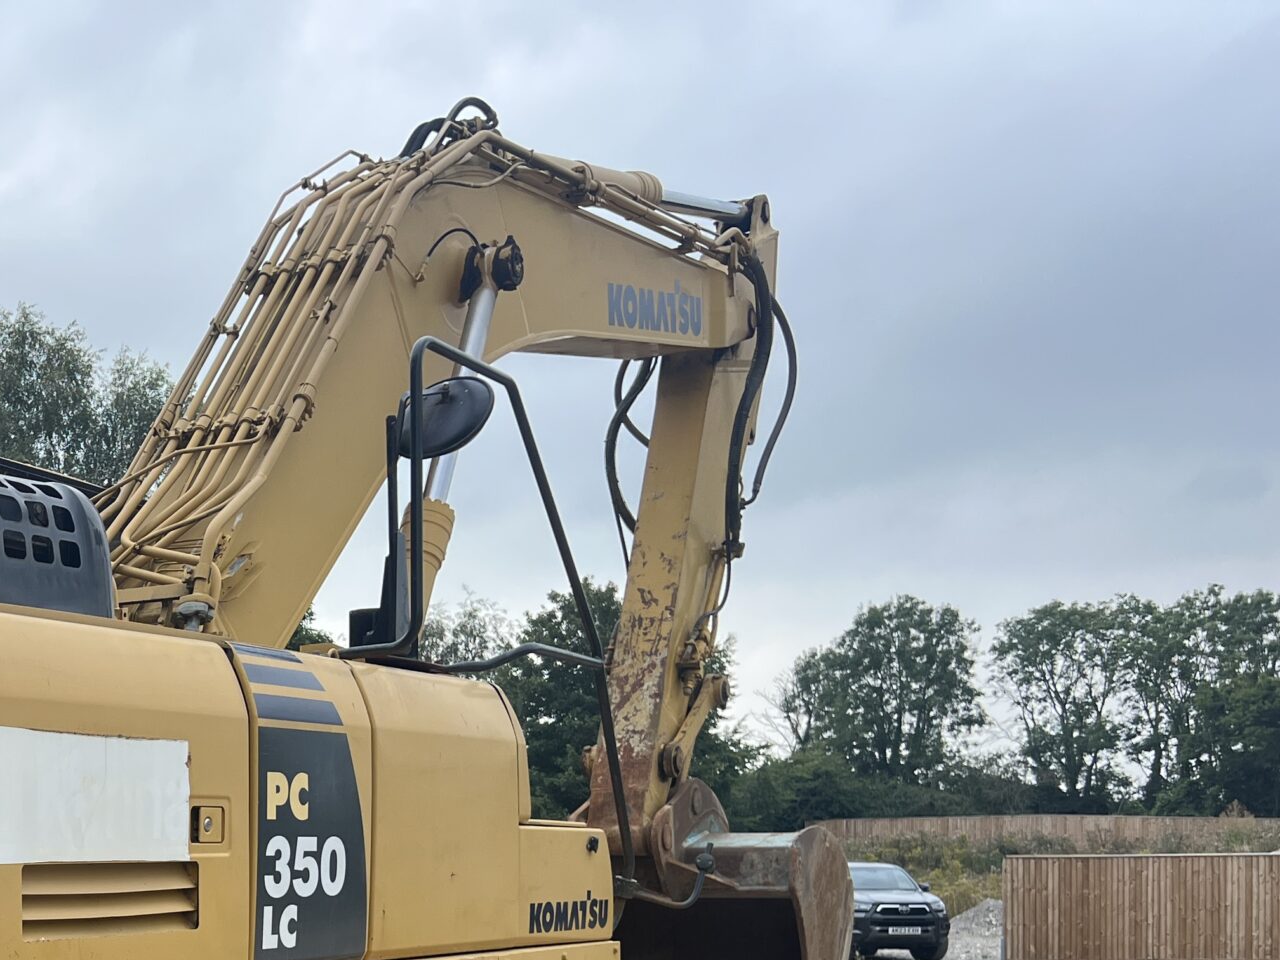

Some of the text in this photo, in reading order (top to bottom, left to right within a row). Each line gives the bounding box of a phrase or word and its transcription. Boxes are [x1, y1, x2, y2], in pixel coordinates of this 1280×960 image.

[607, 279, 702, 336] KOMATSU
[266, 771, 309, 821] PC
[263, 835, 347, 899] 350
[261, 904, 298, 950] LC
[529, 890, 609, 934] KOMATSU
